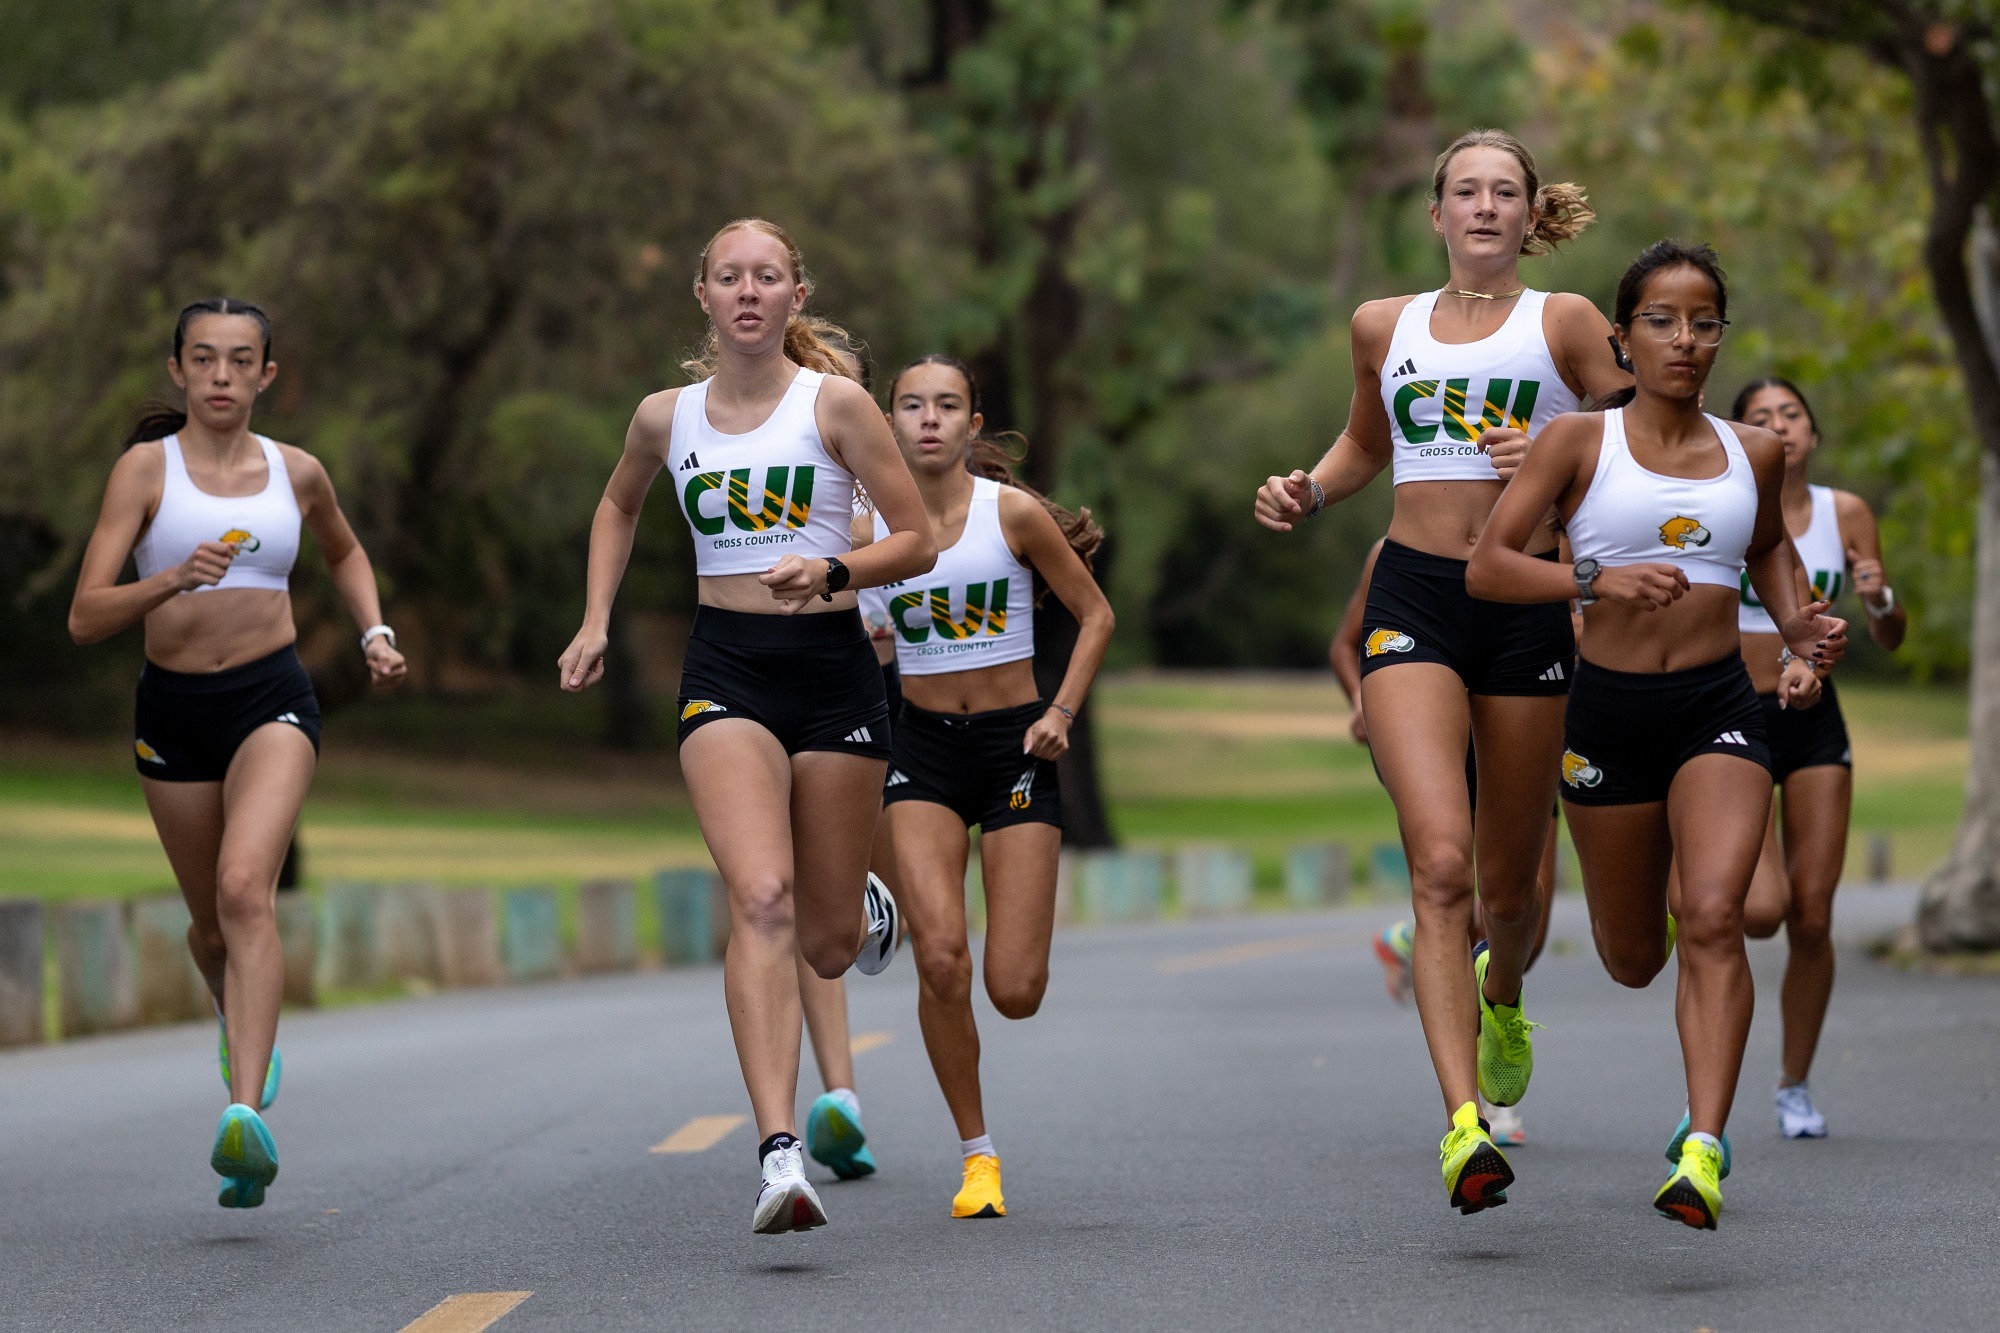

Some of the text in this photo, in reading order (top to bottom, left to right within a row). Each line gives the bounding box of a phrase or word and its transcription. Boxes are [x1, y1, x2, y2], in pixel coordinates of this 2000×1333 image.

[1393, 377, 1541, 445] CUI
[1420, 446, 1490, 457] CROSS COUN
[684, 465, 816, 536] CUI
[713, 533, 796, 550] CROSS COUNTRY
[889, 577, 1010, 644] CUI
[916, 640, 995, 656] CROSS COUNTRY
